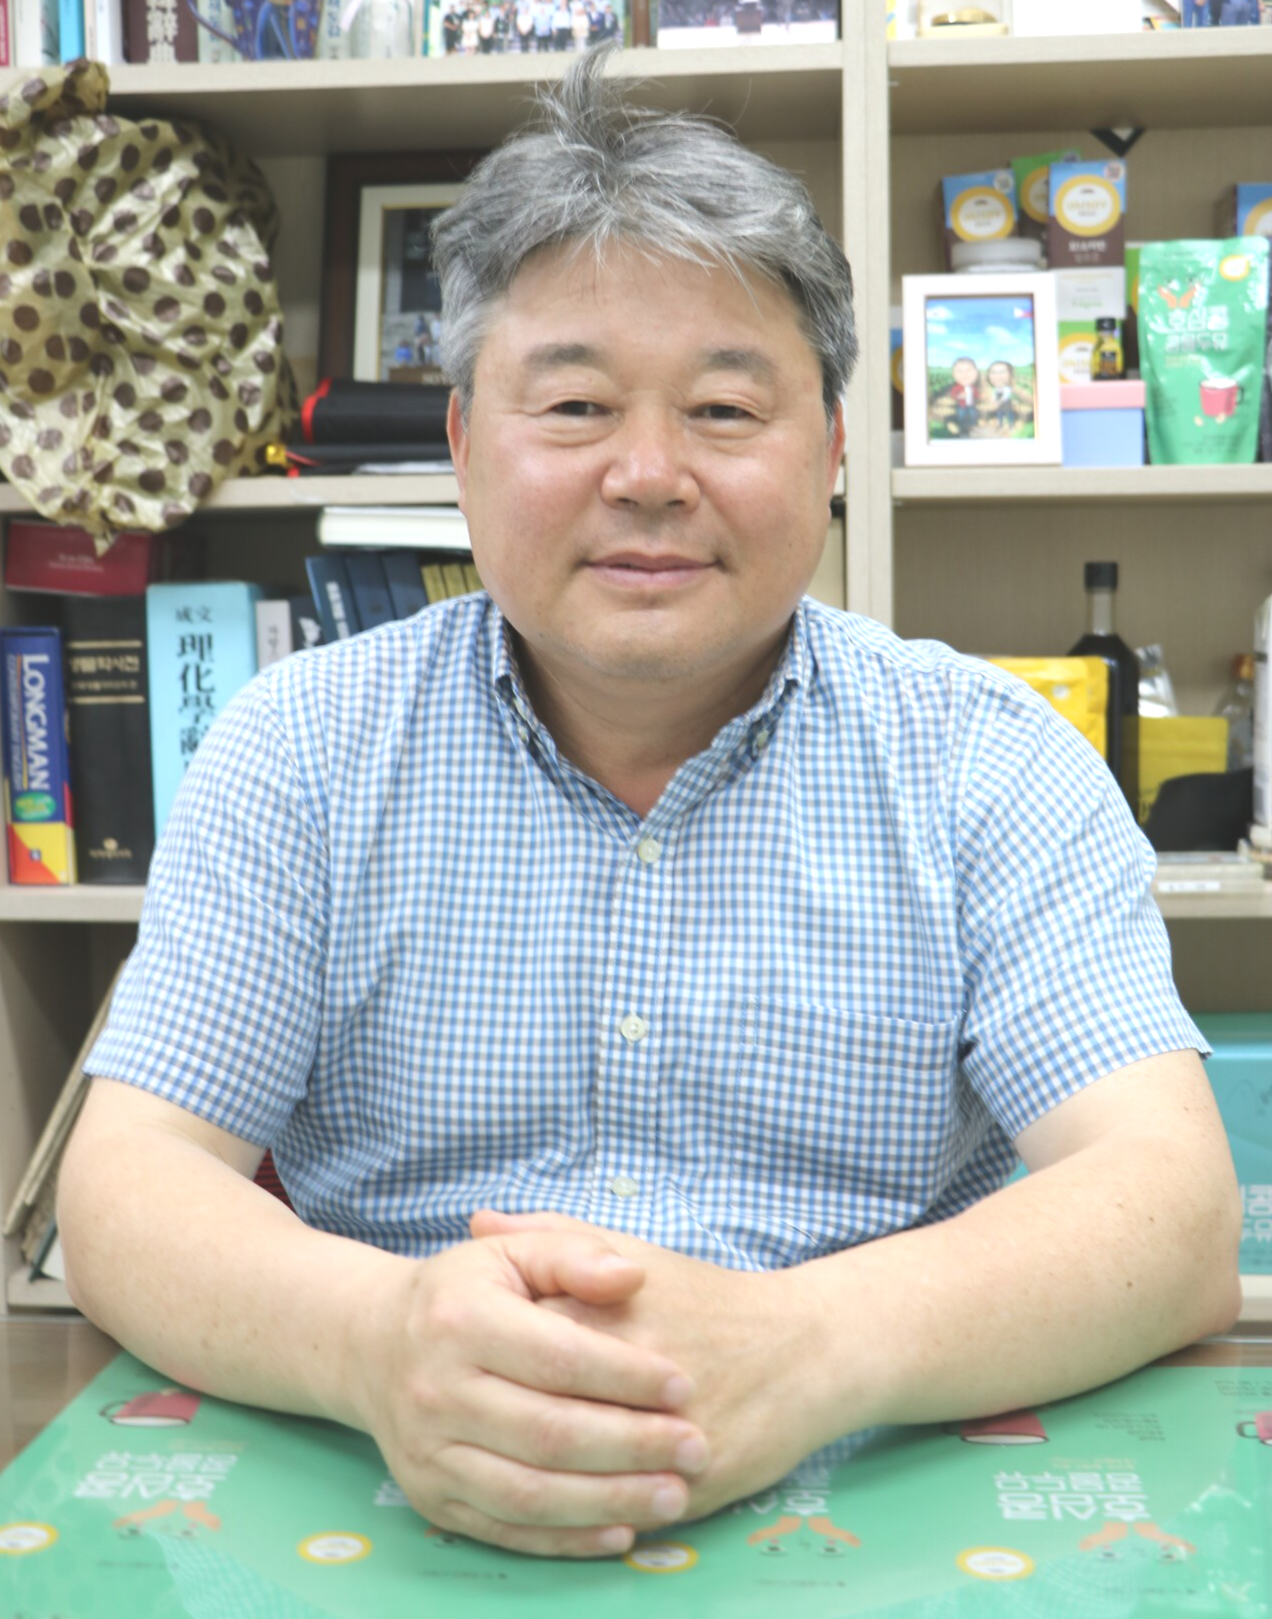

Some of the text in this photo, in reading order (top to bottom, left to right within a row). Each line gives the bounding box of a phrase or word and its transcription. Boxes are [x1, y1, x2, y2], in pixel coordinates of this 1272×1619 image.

[21, 654, 50, 791] LONGMAN
[73, 1472, 227, 1501] 호심콩
[996, 1491, 1151, 1522] 호심콩
